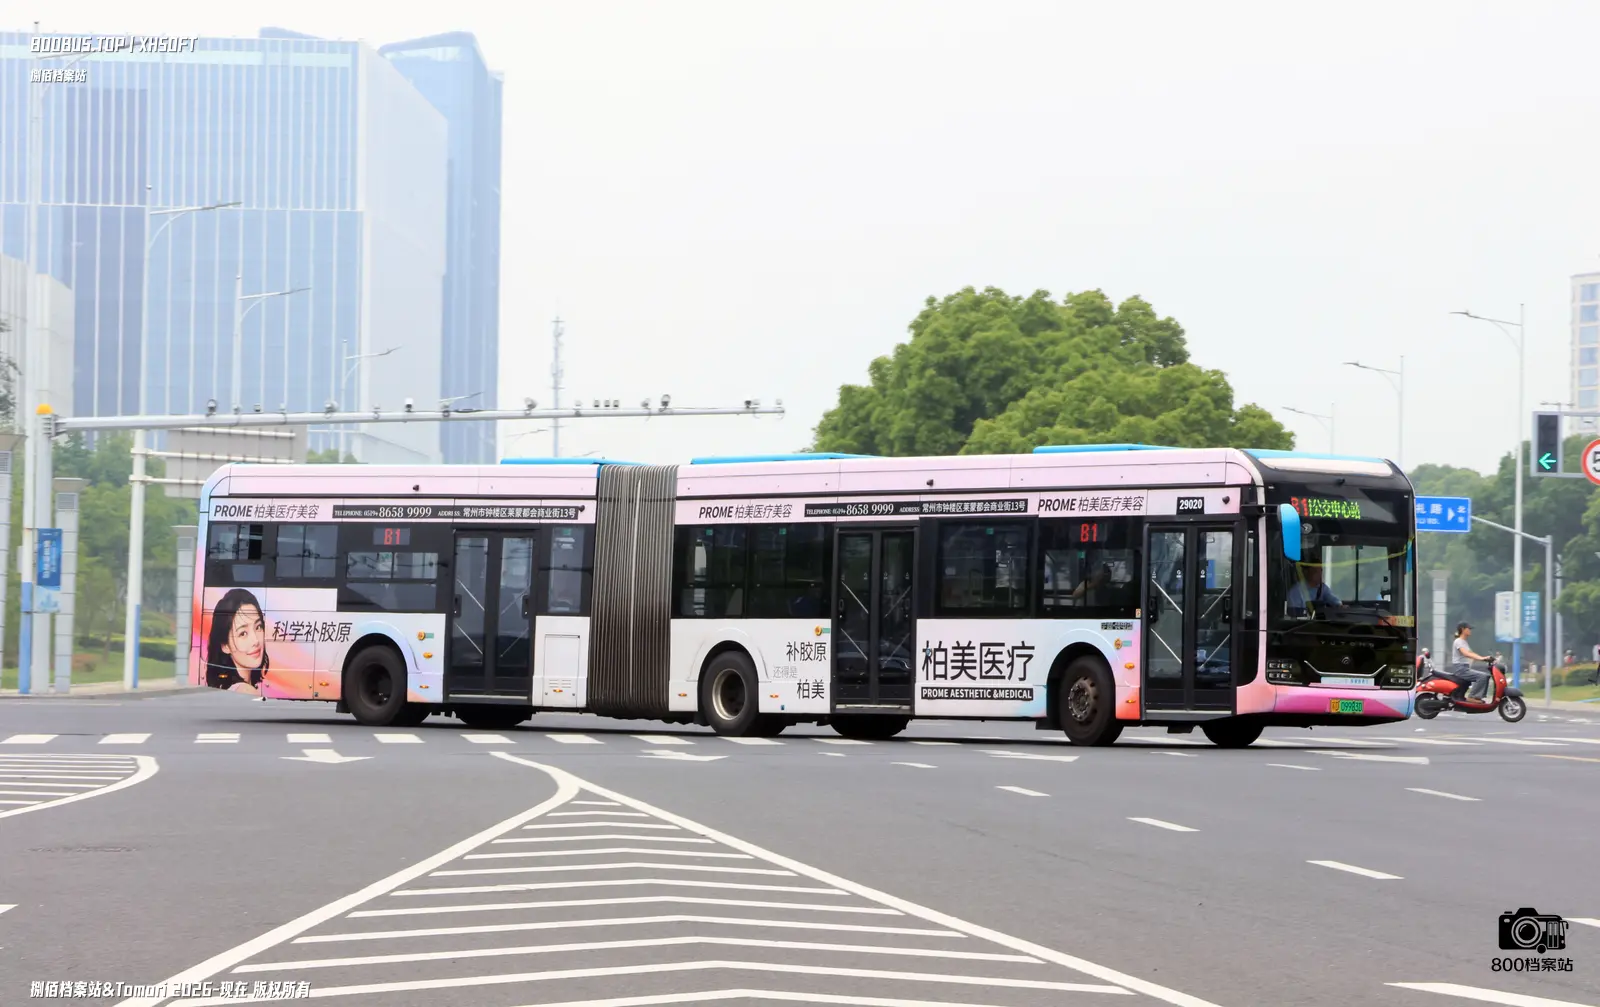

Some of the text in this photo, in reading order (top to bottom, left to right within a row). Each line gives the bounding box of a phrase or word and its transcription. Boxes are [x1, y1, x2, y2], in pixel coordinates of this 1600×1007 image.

[213, 503, 320, 519] PROME 柏美医疗美容
[379, 506, 404, 518] 8658
[407, 506, 432, 518] 9999
[699, 504, 793, 519] PROME 柏美医疗美容
[846, 503, 869, 516] 8658
[871, 502, 894, 515] 9999
[1038, 496, 1144, 512] PROME 柏美医疗美容
[1179, 499, 1203, 510] 29020
[383, 527, 401, 545] B1
[1080, 523, 1098, 542] B1
[272, 621, 353, 643] 科学补胶原
[786, 641, 827, 662] 补胶原
[922, 640, 1036, 682] 柏美医疗
[773, 666, 798, 679] 还得是
[797, 679, 825, 699] 柏美
[922, 688, 949, 699] PROME
[950, 688, 992, 699] AESTHETIC
